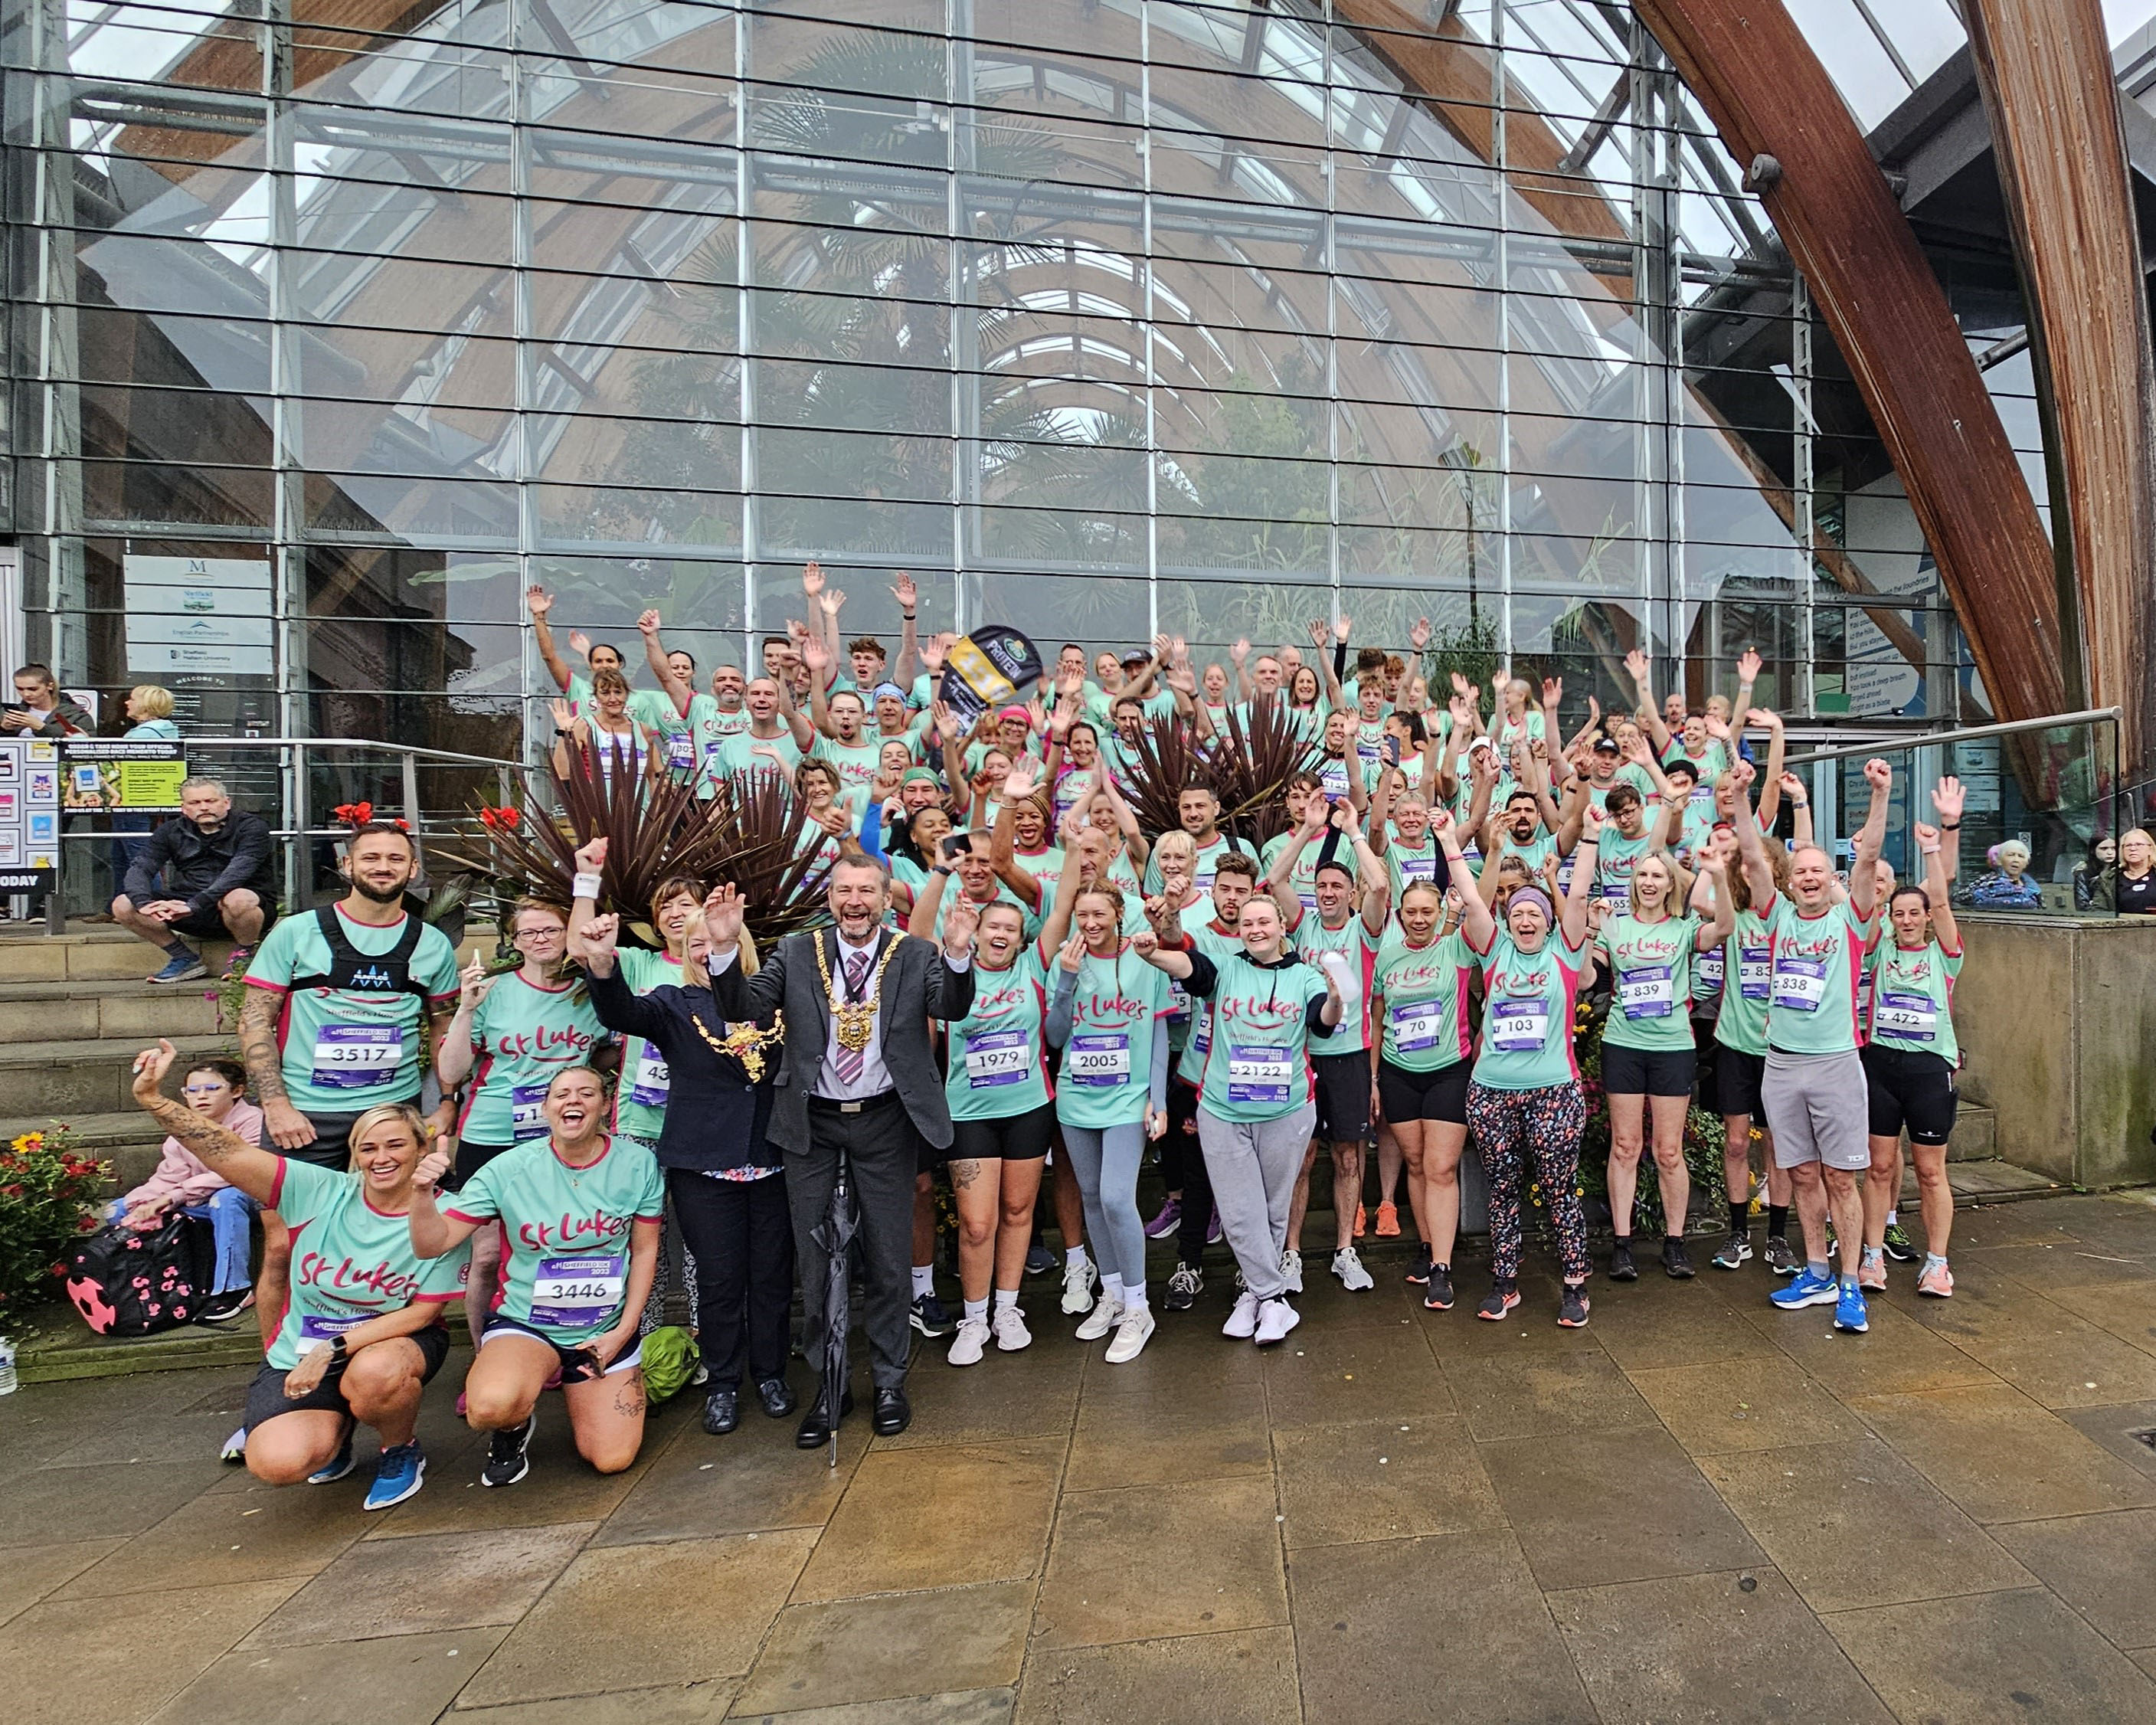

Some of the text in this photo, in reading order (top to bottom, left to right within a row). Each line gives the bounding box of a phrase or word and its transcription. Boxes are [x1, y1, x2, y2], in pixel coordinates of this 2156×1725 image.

[190, 560, 207, 572] M
[986, 639, 1022, 679] PROTEIN
[175, 676, 212, 685] WELCOME
[0, 875, 38, 886] ODAY
[1637, 938, 1678, 956] Luke's
[1782, 977, 1808, 990] 838
[1634, 984, 1659, 997] 839
[1091, 994, 1147, 1020] Luke's
[1222, 996, 1243, 1021] St
[1892, 1013, 1920, 1025] 472
[1410, 1020, 1425, 1033] 70
[1509, 1020, 1533, 1032] 103
[499, 1033, 532, 1062] St
[331, 1048, 388, 1062] 3517
[980, 1051, 1019, 1067] 1979
[1080, 1055, 1117, 1067] 2005
[1242, 1065, 1281, 1077] 2122
[519, 1221, 555, 1251] St
[298, 1252, 420, 1301] St Luke's
[551, 1284, 607, 1299] 3446
